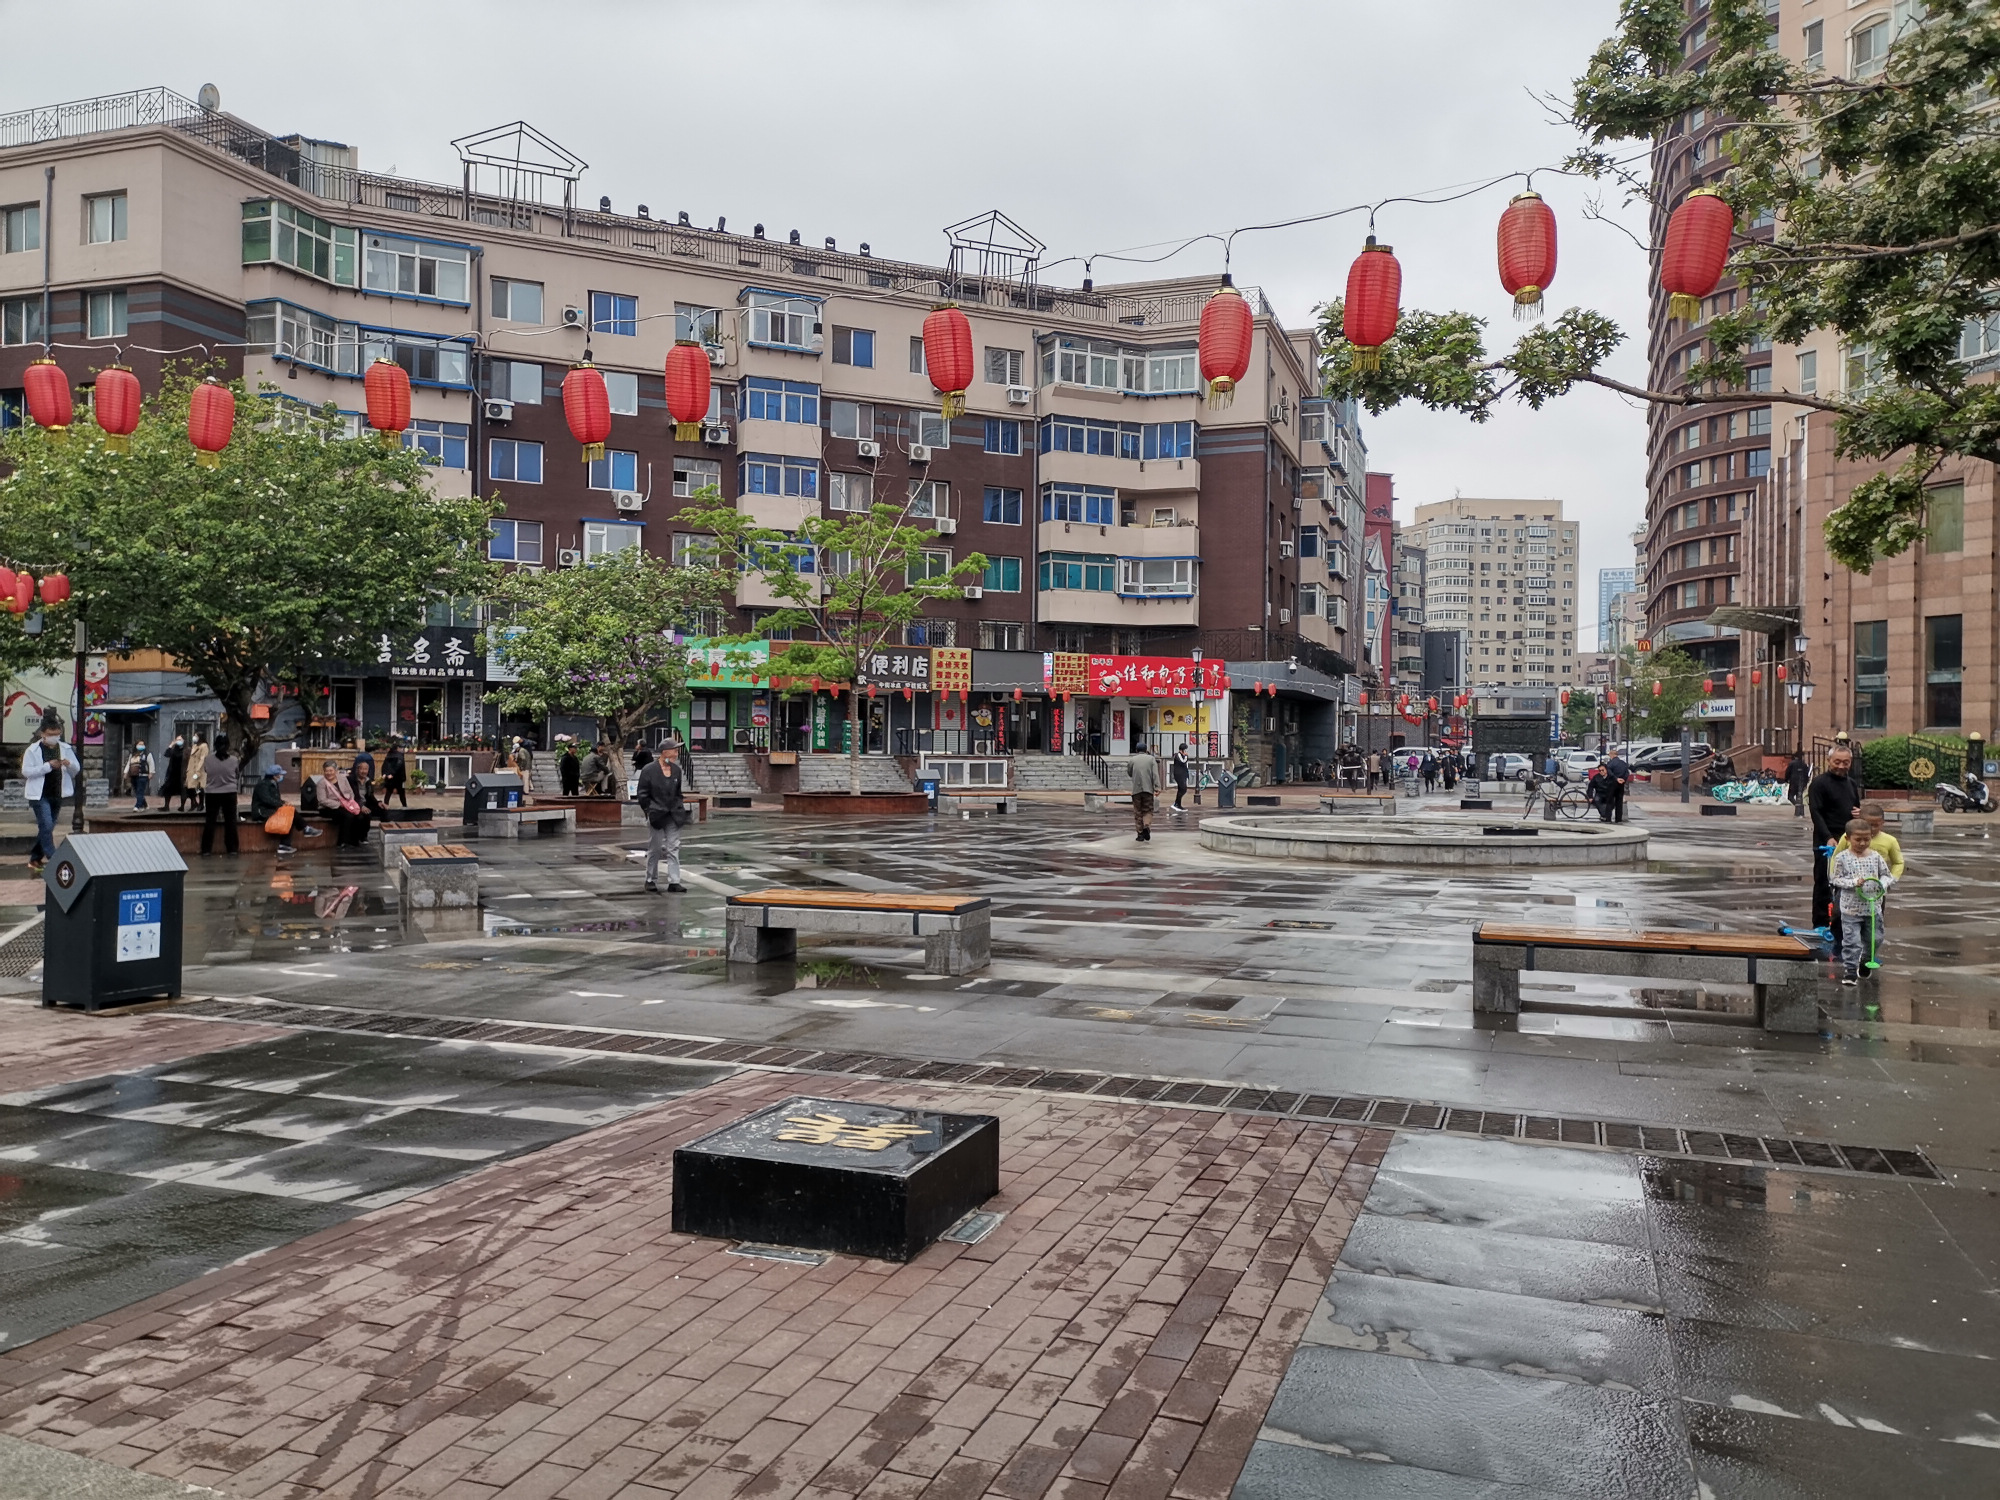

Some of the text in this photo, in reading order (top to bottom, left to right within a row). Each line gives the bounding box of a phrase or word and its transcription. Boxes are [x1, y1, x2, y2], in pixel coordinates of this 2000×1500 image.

[376, 633, 471, 667] 吉名斋
[1711, 705, 1733, 713] SMART
